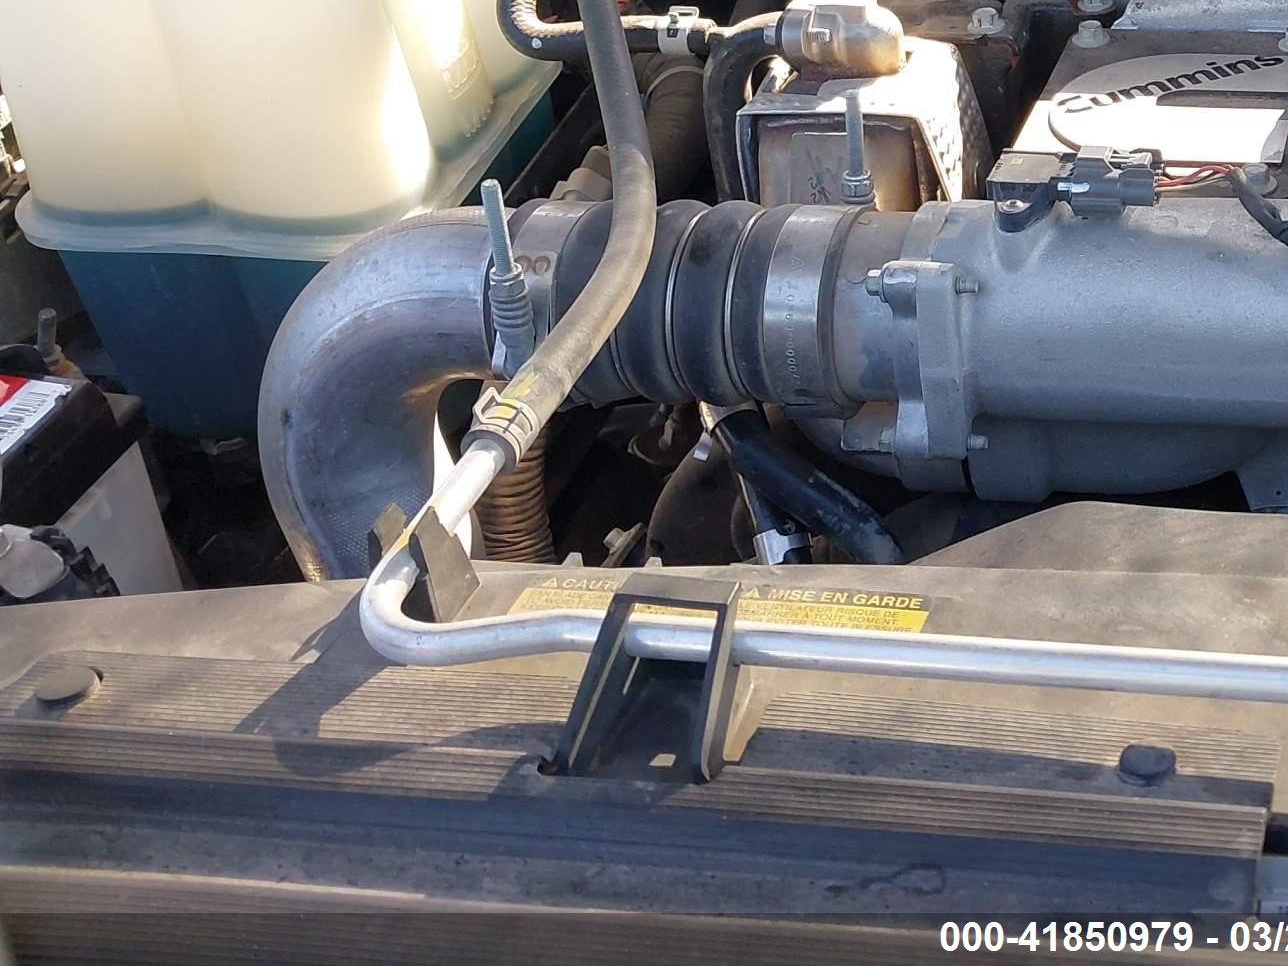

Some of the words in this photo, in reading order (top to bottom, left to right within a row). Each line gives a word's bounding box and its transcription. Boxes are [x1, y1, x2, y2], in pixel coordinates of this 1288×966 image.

[1057, 55, 1285, 114] Cummins
[767, 588, 817, 602] MISE
[819, 591, 849, 604] EN
[852, 593, 924, 610] GARDE
[814, 613, 846, 622] TOUT
[837, 607, 881, 617] RISQUE
[884, 610, 900, 619] DE
